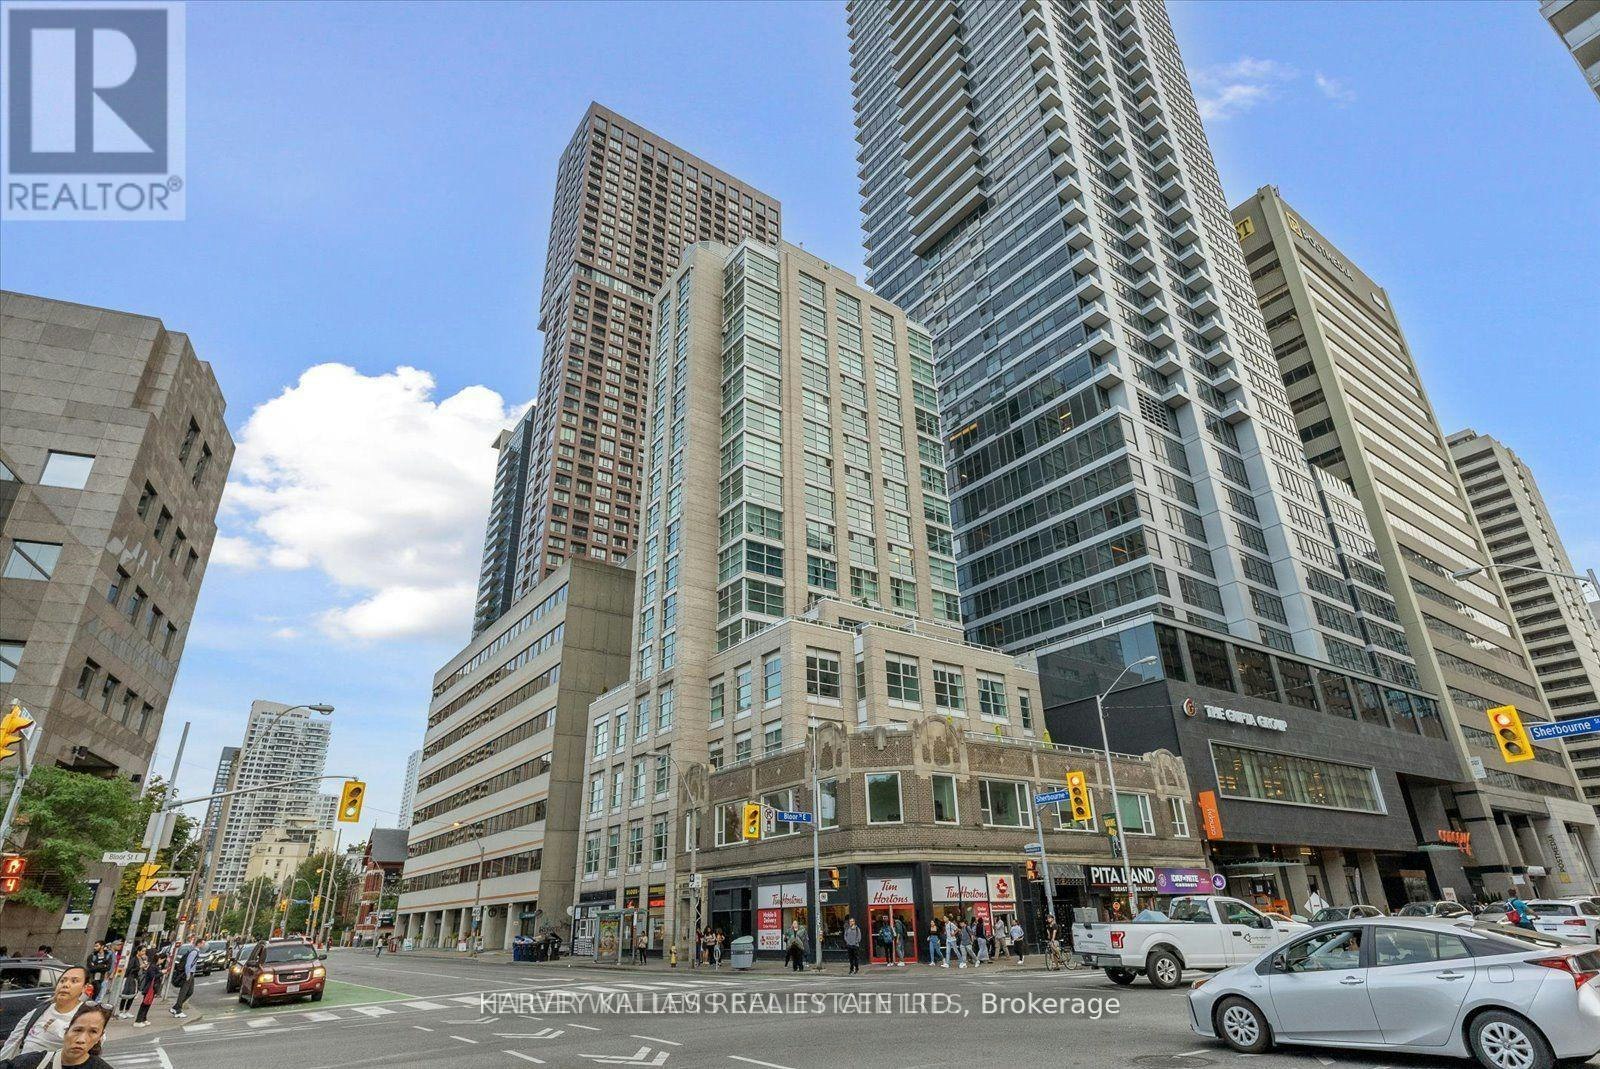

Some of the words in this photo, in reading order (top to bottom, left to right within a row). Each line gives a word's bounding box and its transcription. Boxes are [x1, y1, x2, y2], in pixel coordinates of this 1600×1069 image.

[1533, 721, 1592, 737] Sherbourne
[1036, 792, 1065, 803] Sherbourne
[783, 812, 798, 820] Bloor
[802, 813, 807, 821] E
[109, 853, 127, 861] Bloor
[1091, 866, 1119, 884] PITA
[1121, 867, 1156, 884] LAND
[881, 879, 898, 891] Tim
[873, 892, 908, 903] Hortons
[959, 885, 988, 899] Hortons
[781, 892, 803, 906] Hortons
